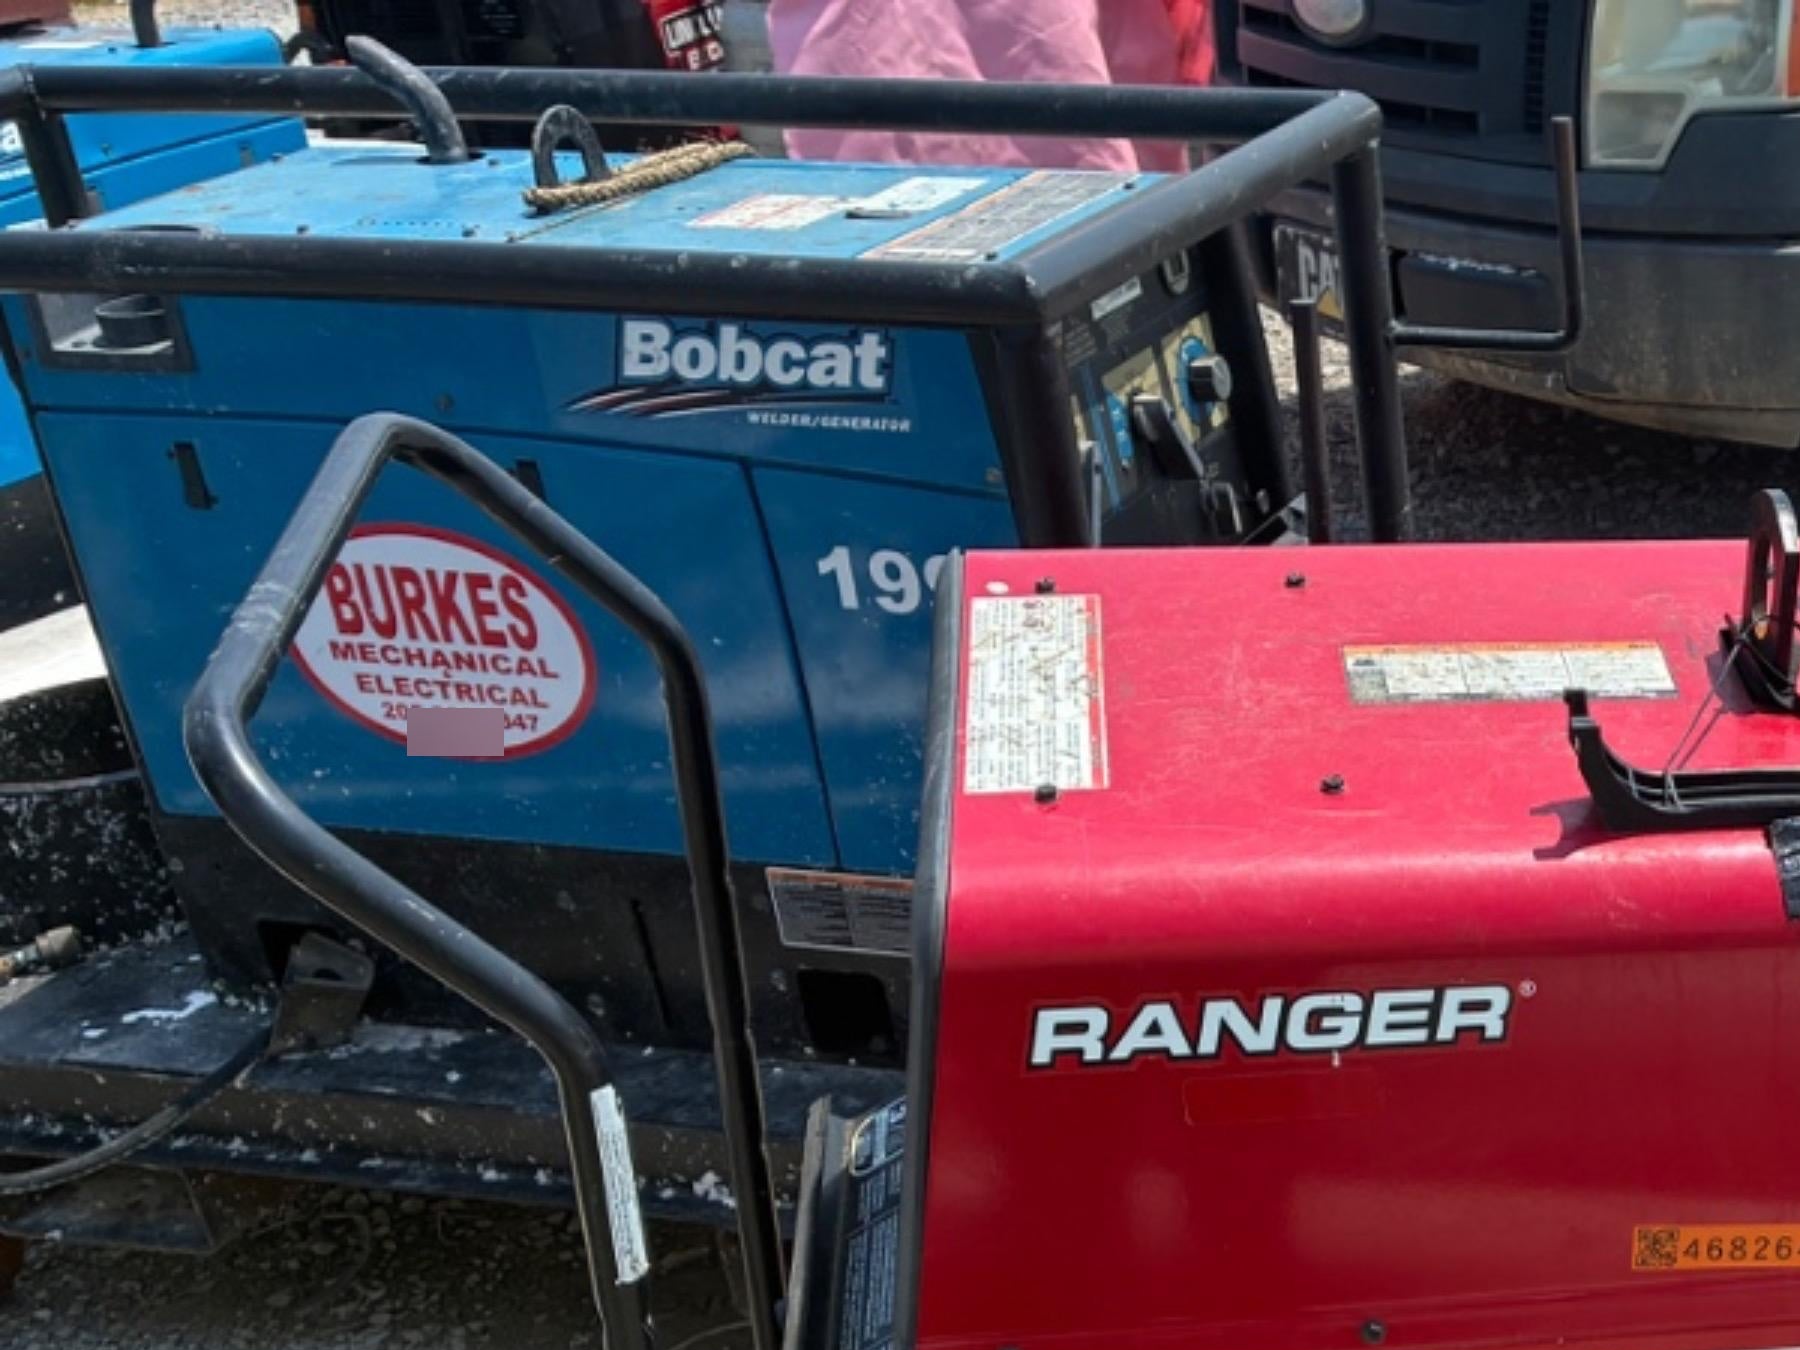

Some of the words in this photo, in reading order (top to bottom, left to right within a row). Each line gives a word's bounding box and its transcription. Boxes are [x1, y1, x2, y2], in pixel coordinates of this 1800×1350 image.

[622, 319, 887, 389] Bobcat
[746, 411, 912, 432] WELDER/GENERATOR
[325, 562, 538, 651] BURKES
[328, 641, 560, 679] MECHANICAL
[354, 673, 549, 709] ELECTRICAL
